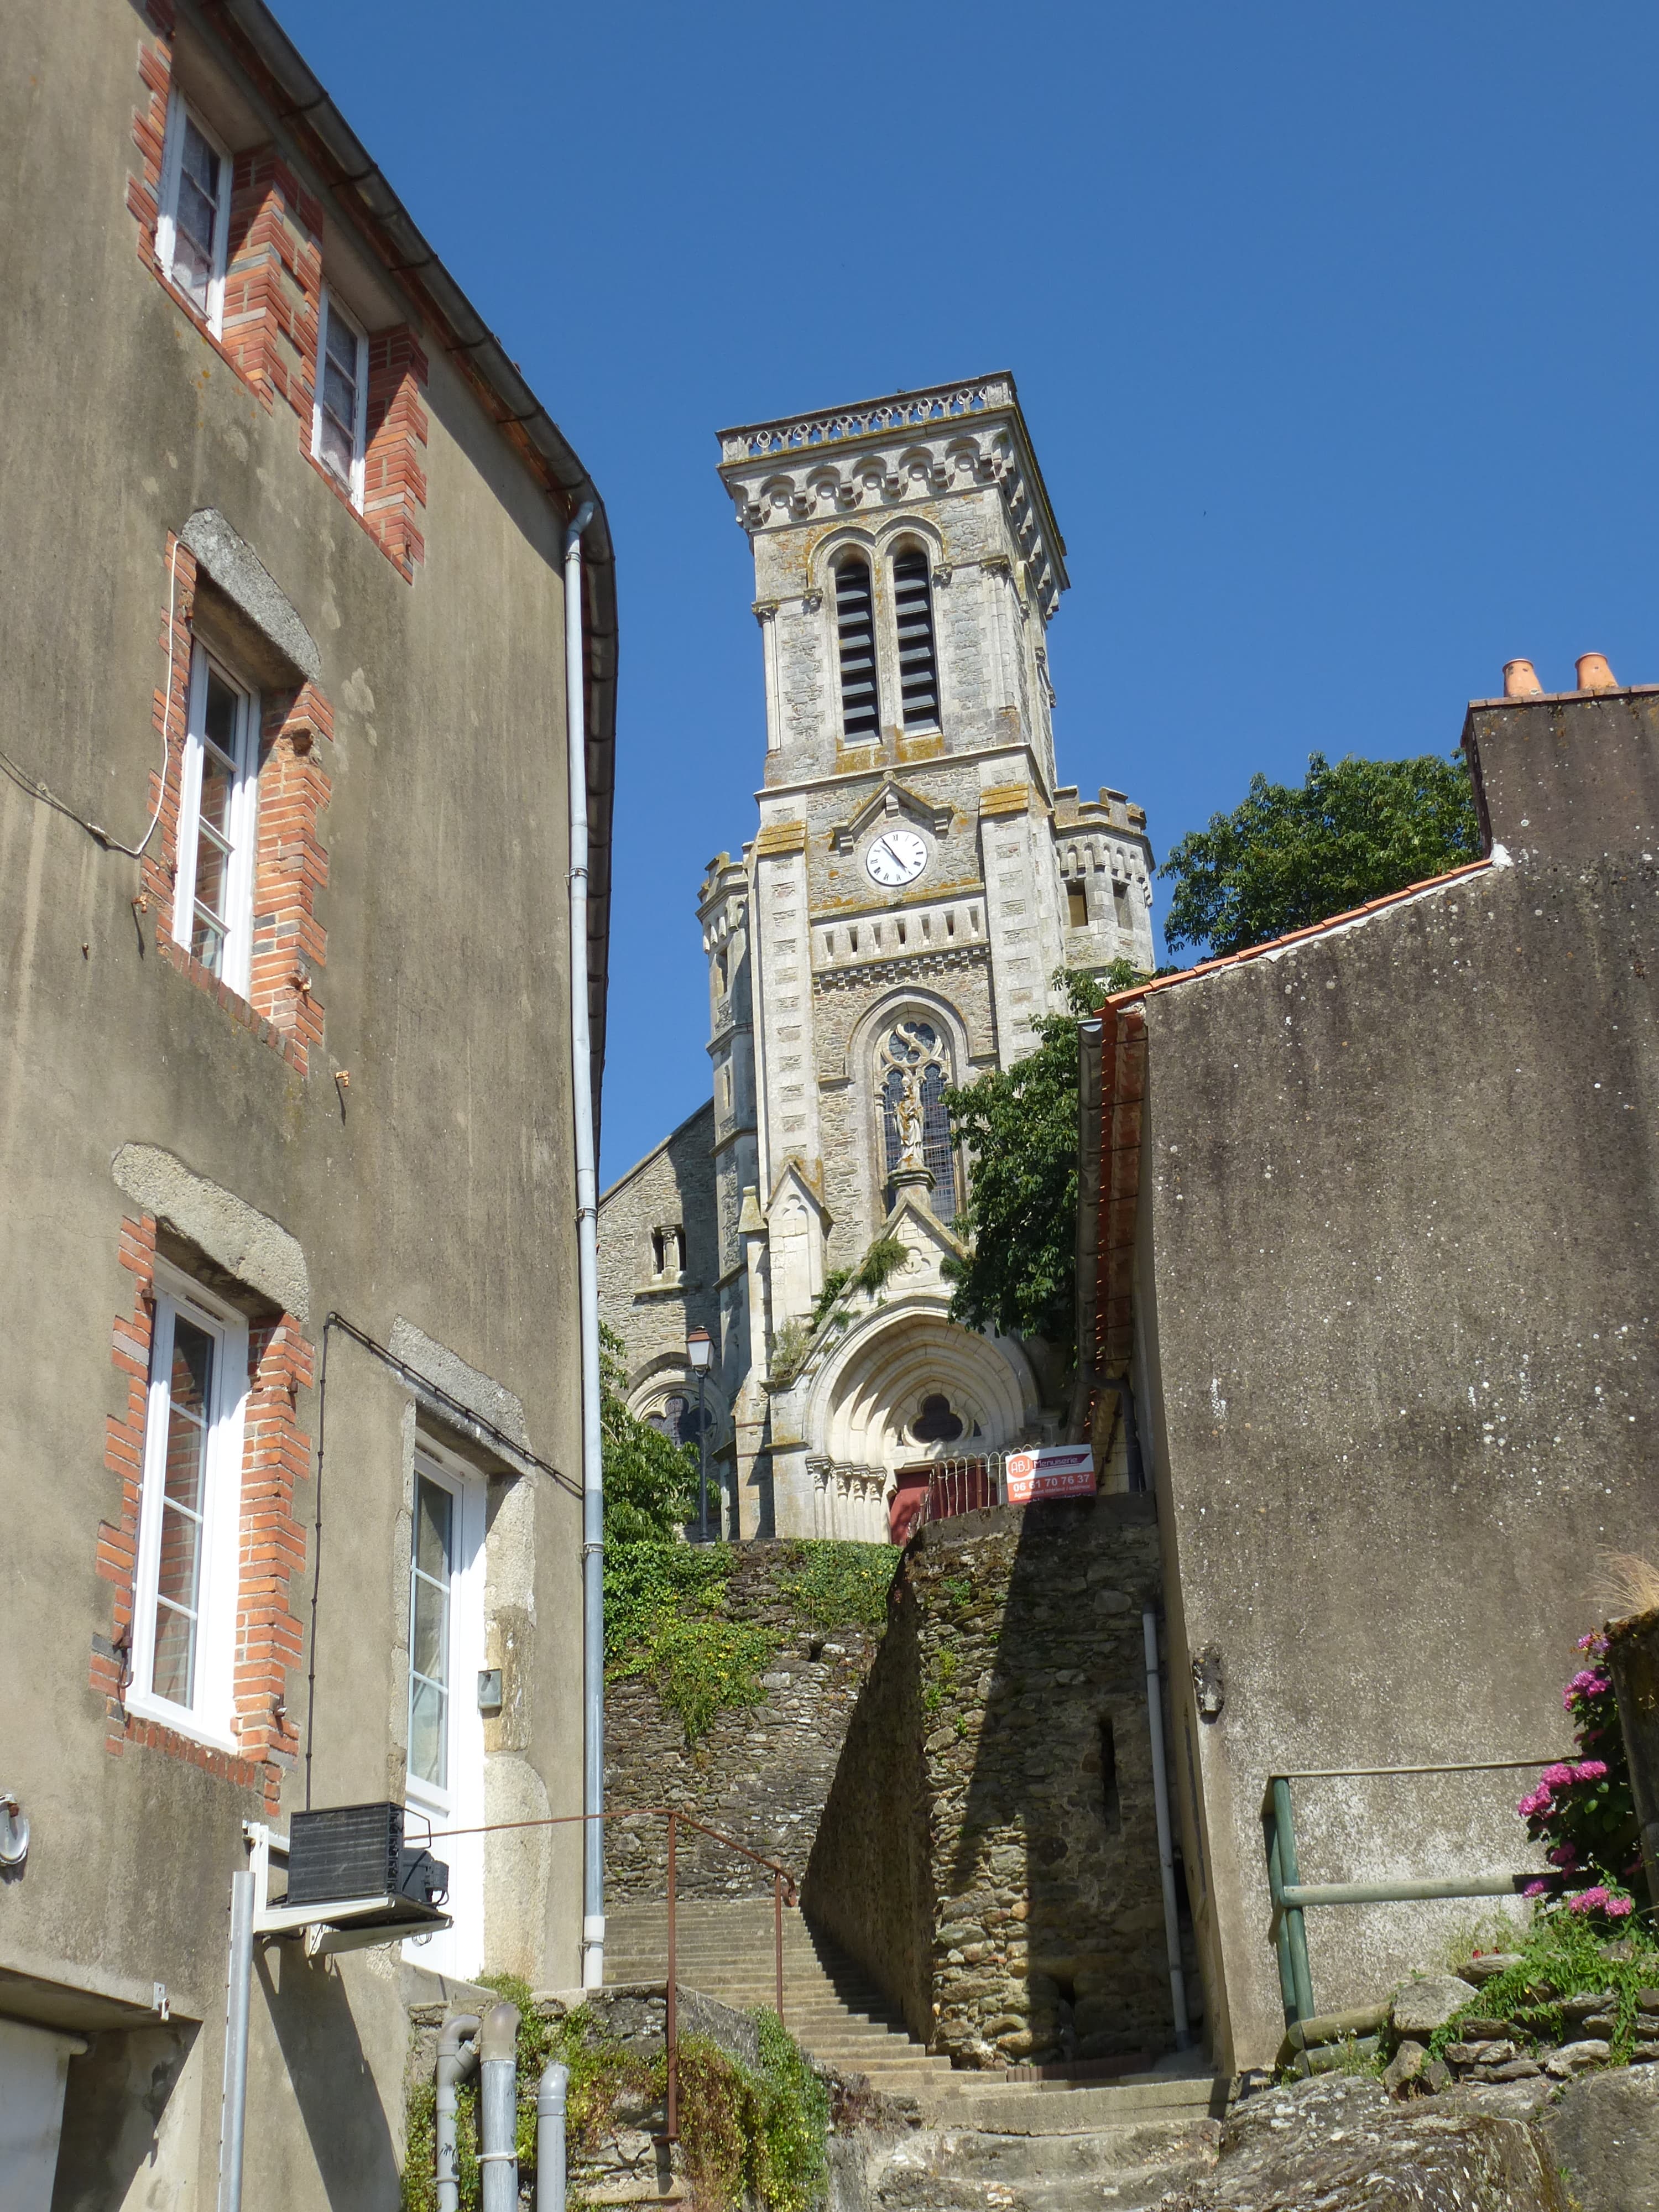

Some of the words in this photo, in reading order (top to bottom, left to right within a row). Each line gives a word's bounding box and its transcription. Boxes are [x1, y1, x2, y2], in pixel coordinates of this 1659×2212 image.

[1011, 1460, 1030, 1473] ABJ
[1013, 1483, 1026, 1492] 06
[1029, 1480, 1040, 1489] 61
[1045, 1478, 1057, 1486] 70
[1061, 1476, 1074, 1485] 76
[1077, 1474, 1089, 1483] 37
